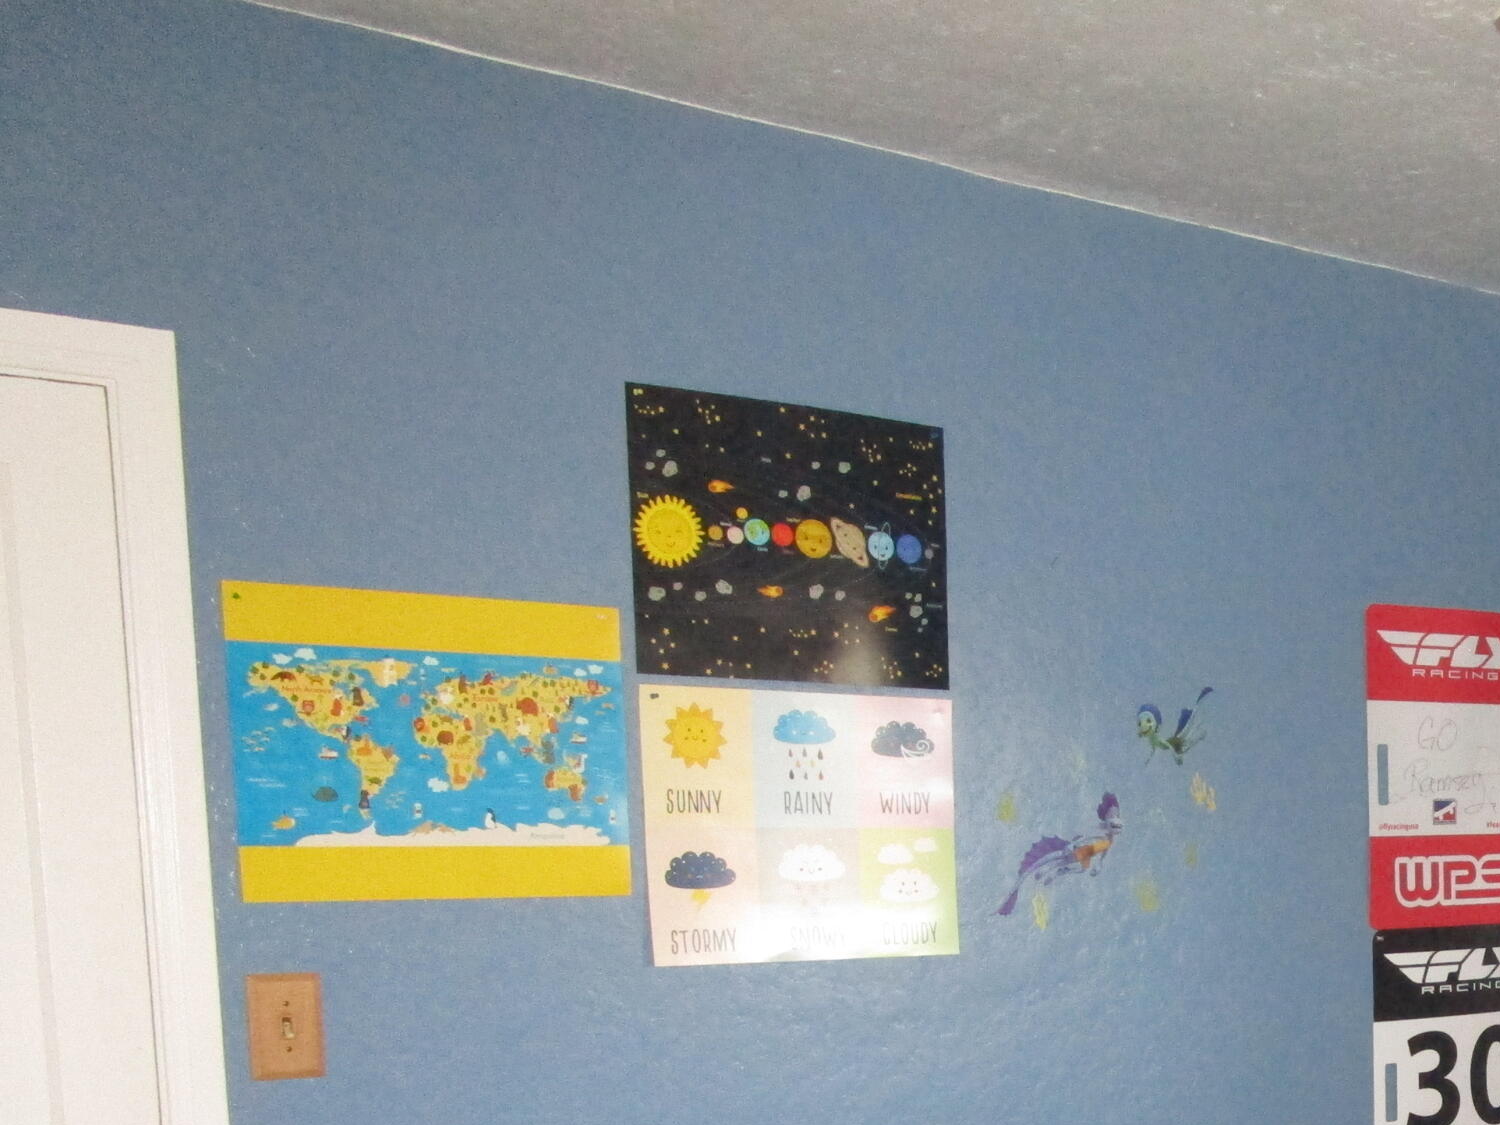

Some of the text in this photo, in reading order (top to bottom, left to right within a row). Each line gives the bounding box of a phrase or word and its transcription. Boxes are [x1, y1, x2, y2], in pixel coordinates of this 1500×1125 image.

[1412, 668, 1500, 681] RACING
[666, 789, 722, 814] SUNNY
[783, 791, 833, 815] RAINY
[879, 791, 931, 815] WINDY
[671, 928, 738, 955] STORMY
[883, 921, 937, 945] CLOUDY
